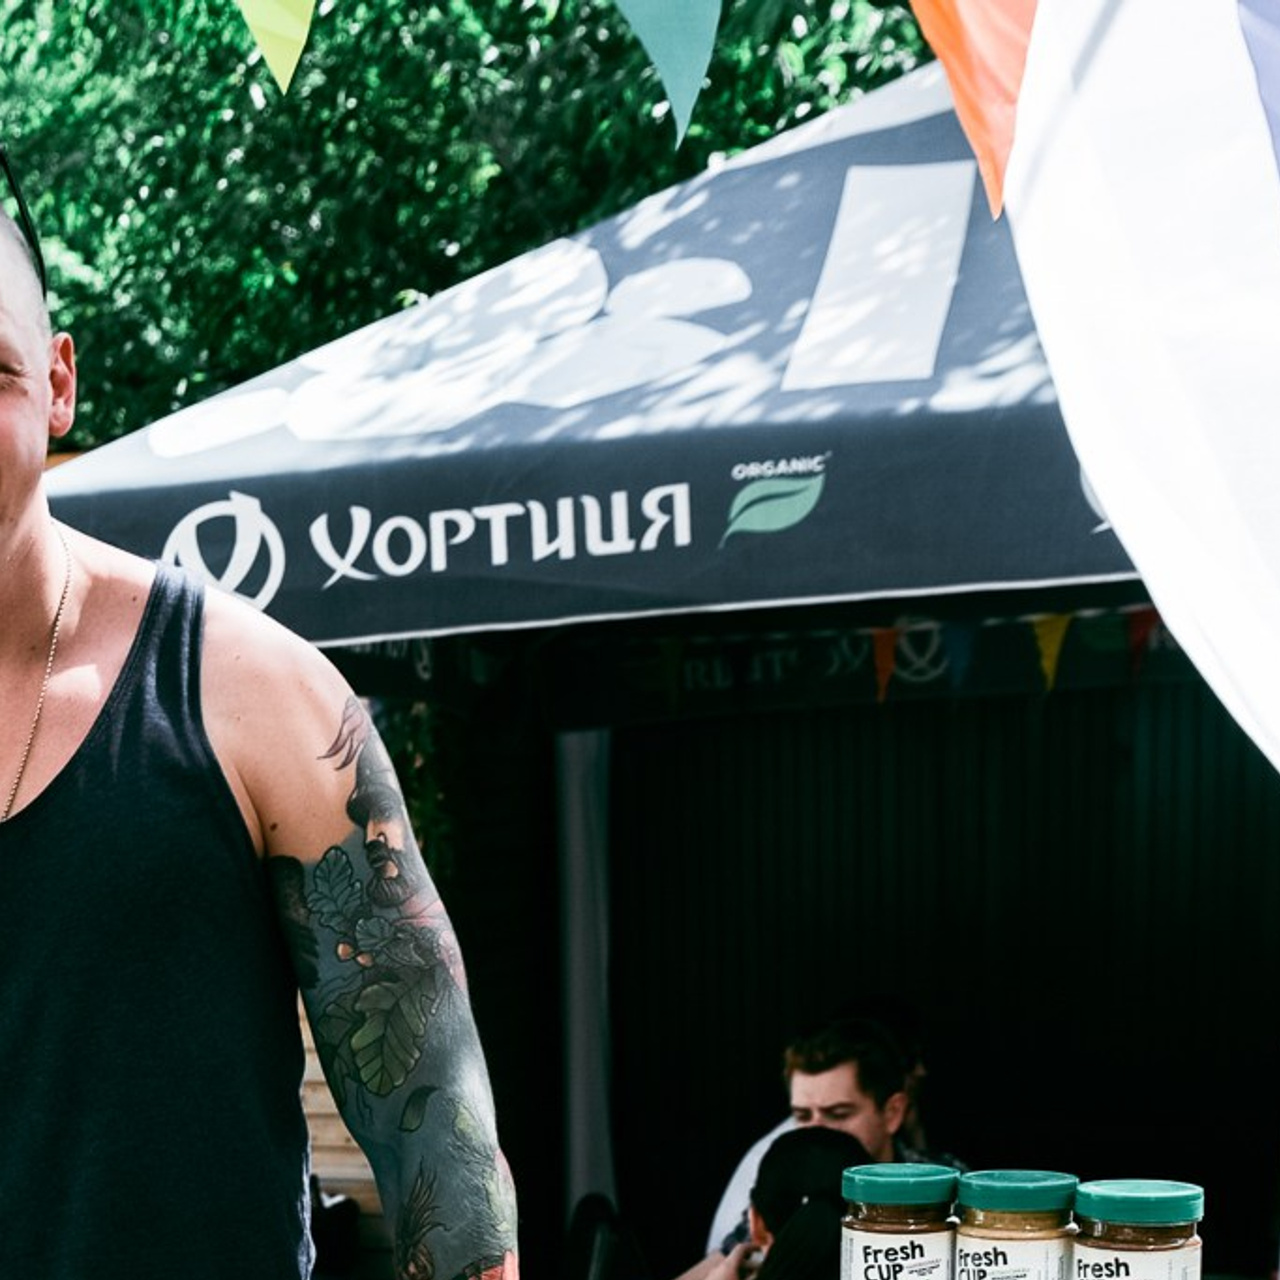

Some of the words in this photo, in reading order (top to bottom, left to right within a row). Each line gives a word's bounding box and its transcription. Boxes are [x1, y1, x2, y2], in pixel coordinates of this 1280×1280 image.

[731, 453, 826, 480] ORGANIC
[309, 482, 692, 590] ХОРТИЦЯ
[863, 1240, 924, 1263] Fresh
[958, 1246, 1007, 1267] Fresh
[1078, 1257, 1129, 1278] Fresh
